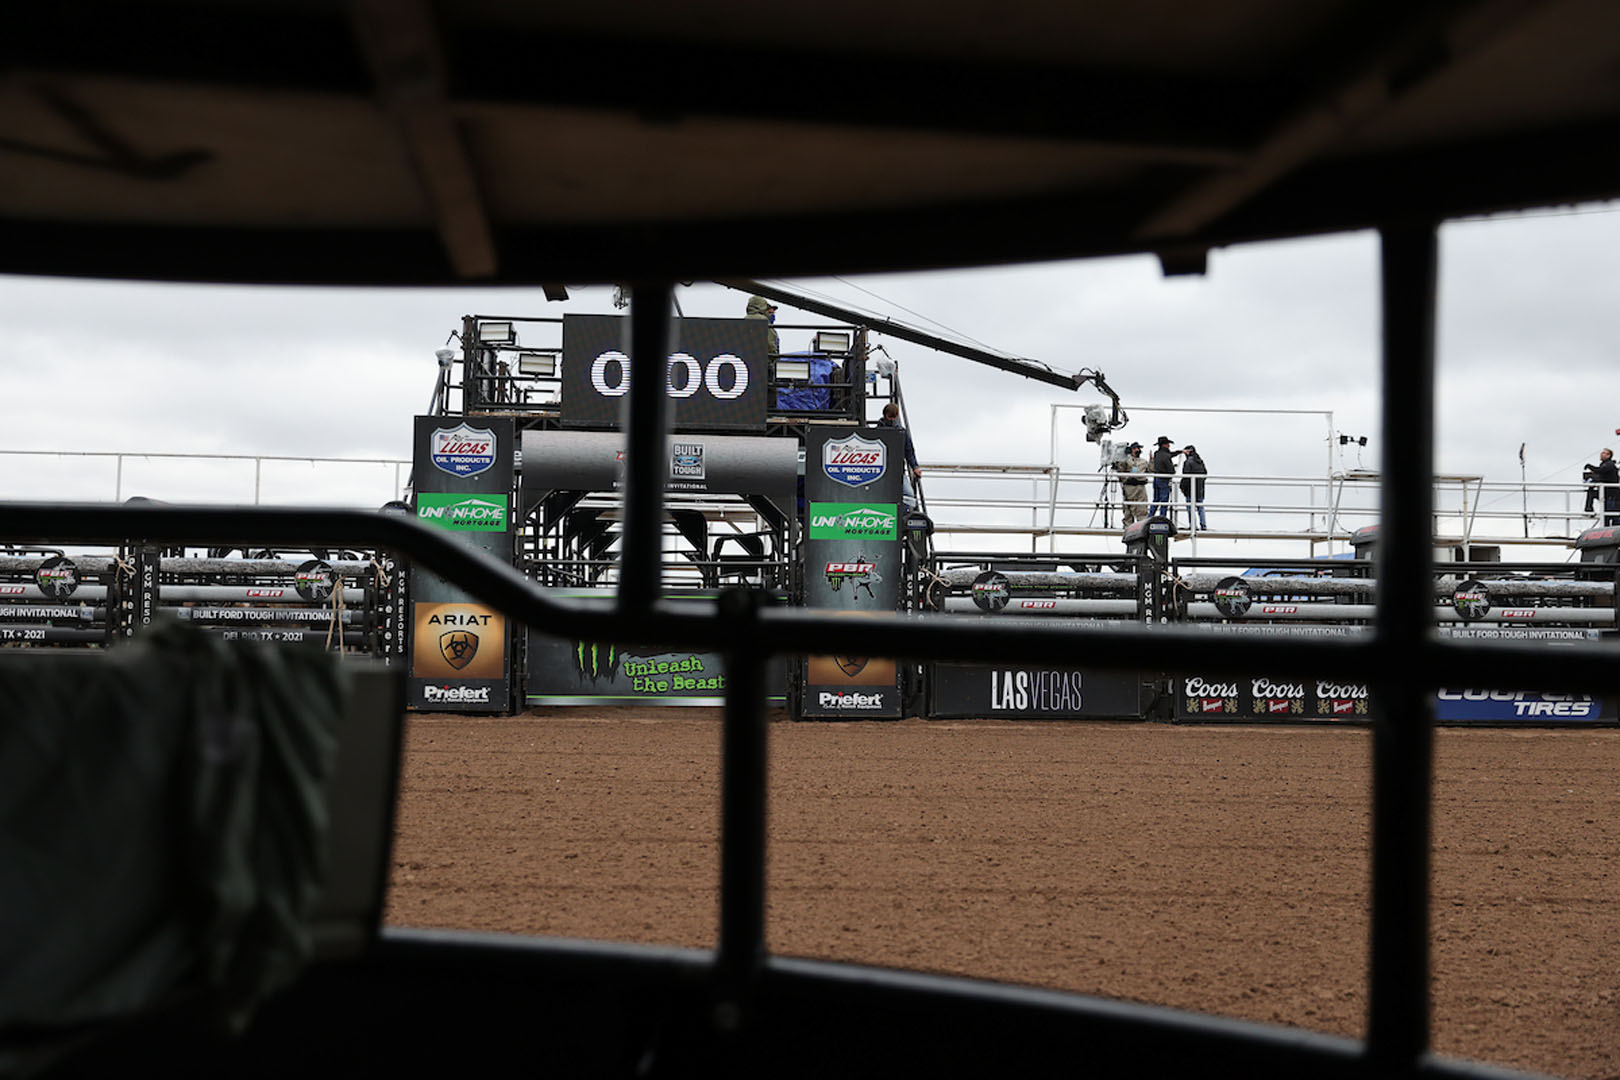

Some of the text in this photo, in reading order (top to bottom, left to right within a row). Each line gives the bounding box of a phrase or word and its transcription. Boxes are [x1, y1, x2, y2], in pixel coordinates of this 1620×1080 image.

[440, 442, 490, 454] LUCAS
[674, 445, 702, 456] BUILT
[436, 456, 450, 464] OIL
[831, 452, 881, 464] LUCAS
[674, 466, 702, 475] TOUGH
[826, 564, 875, 573] PBR
[18, 608, 79, 618] INVITATIONAL
[193, 610, 217, 619] BUILT
[219, 611, 243, 619] FORD
[245, 611, 274, 620] TOUGH
[397, 598, 405, 653] RESORTS
[428, 615, 492, 625] ARIAT
[3, 630, 46, 639] TX 2021
[261, 632, 273, 641] TX
[282, 633, 304, 641] 2021
[1262, 627, 1291, 636] TOUGH
[1292, 627, 1347, 637] INVITATIONAL
[1452, 631, 1585, 640] BUILT FORD TOUGH INVITATIONAL
[624, 656, 704, 677] Unleash
[633, 675, 727, 693] the Beast
[1185, 677, 1239, 698] Coors
[1251, 678, 1304, 699] Coors
[1316, 680, 1369, 699] Coors
[424, 686, 487, 699] Priefert
[819, 692, 882, 705] Priefert
[1513, 702, 1592, 716] TIRES
